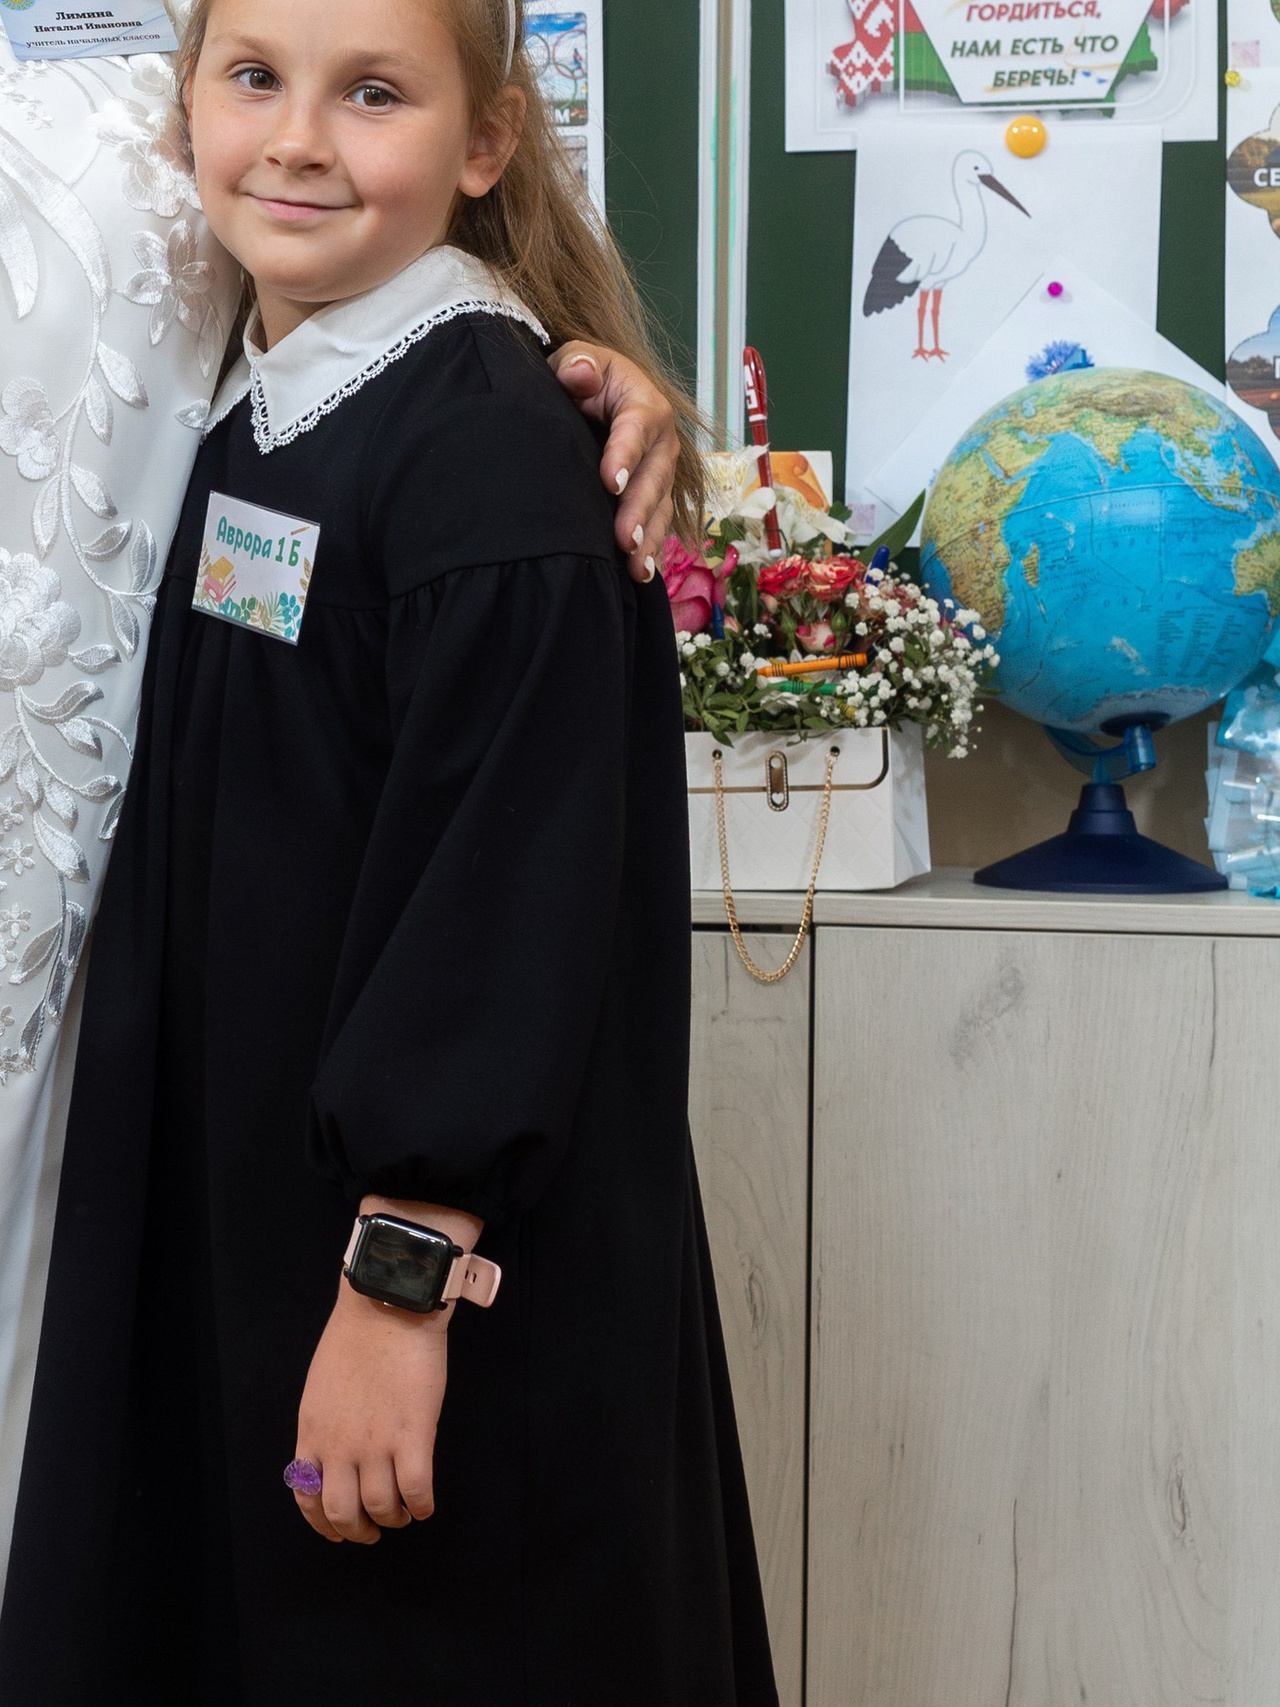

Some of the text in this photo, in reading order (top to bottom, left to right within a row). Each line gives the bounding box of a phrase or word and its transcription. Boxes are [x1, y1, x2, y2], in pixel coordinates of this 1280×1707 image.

[55, 10, 114, 20] Лимина
[966, 1, 1102, 22] ГОРДИТЬСЯ,
[34, 20, 143, 33] Наталья Ивановна
[25, 32, 161, 49] учитель начальных классов
[951, 35, 1119, 58] НАМ ЕСТЬ ЧТО
[992, 68, 1078, 88] БЕРЕЧЬ!
[216, 516, 273, 561] Аврора
